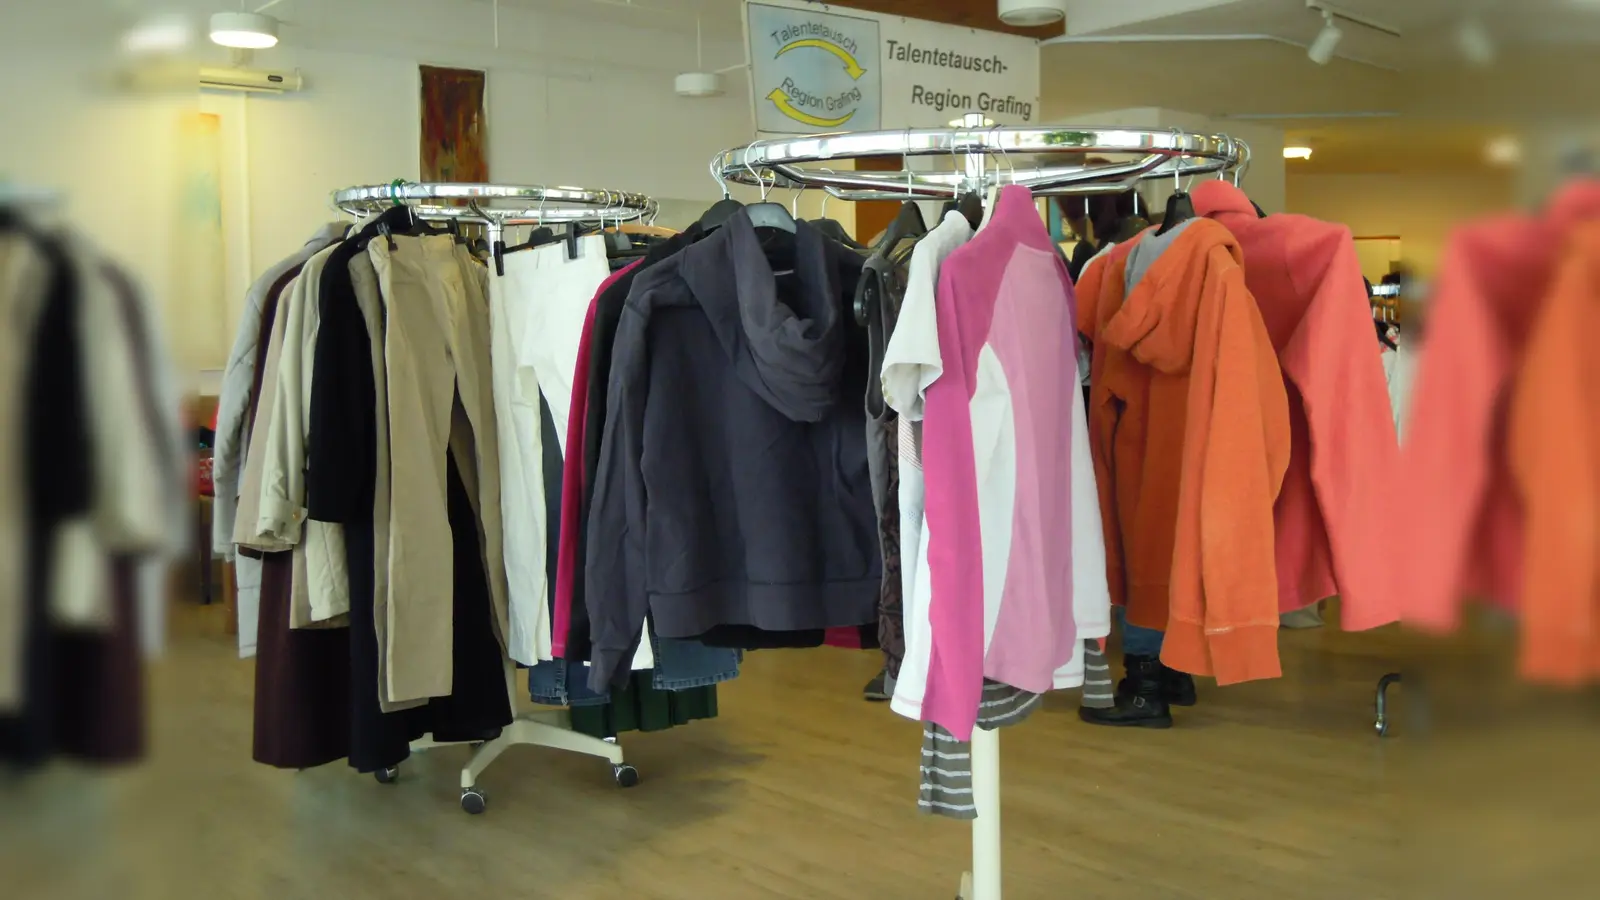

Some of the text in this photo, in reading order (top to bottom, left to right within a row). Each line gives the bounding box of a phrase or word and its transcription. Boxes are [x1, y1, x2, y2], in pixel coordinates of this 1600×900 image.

[770, 21, 858, 54] Talentetausch
[886, 40, 1008, 74] Talentetausch-
[780, 76, 862, 111] Region Grafing
[911, 85, 1032, 121] Region Grafing
